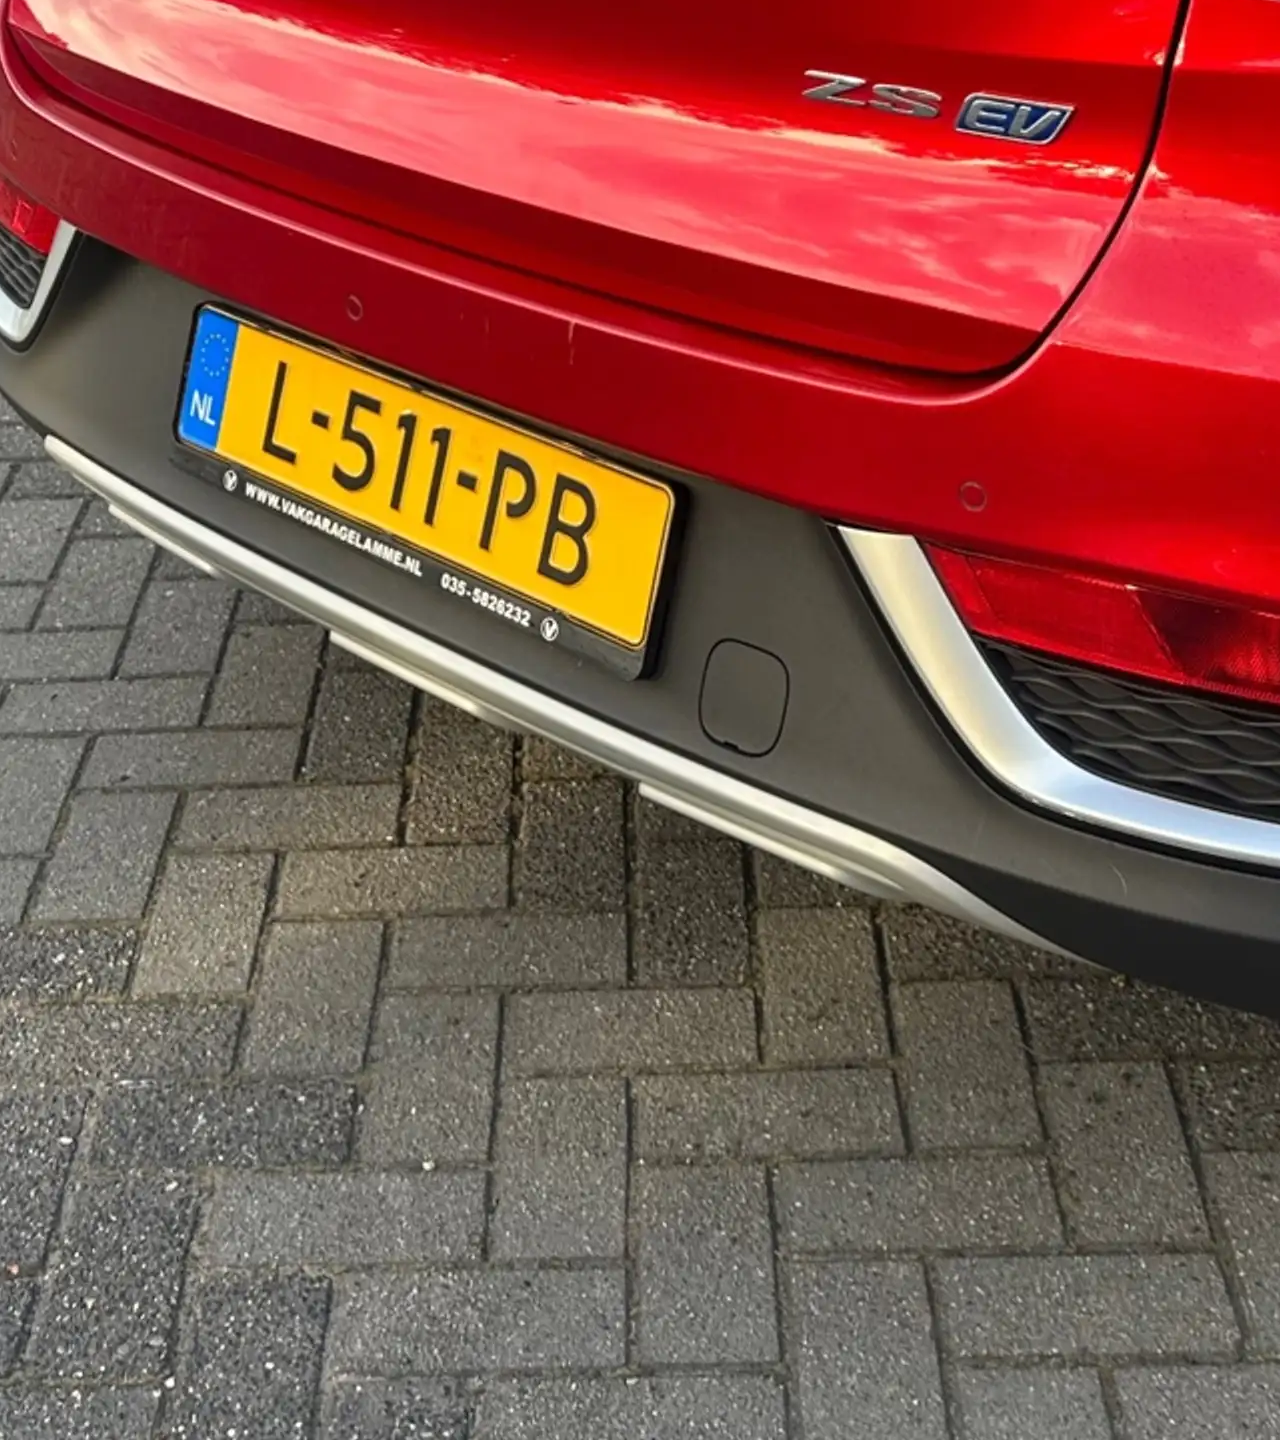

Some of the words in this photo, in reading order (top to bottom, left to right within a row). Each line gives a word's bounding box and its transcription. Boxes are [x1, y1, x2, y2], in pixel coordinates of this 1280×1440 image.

[801, 69, 943, 119] ZS
[966, 97, 1062, 139] EV
[190, 389, 216, 427] NL
[261, 360, 599, 588] L-511-PB
[244, 480, 423, 578] WWW.VAKGARAGELAMME.NL
[440, 571, 532, 628] 035-5826232
